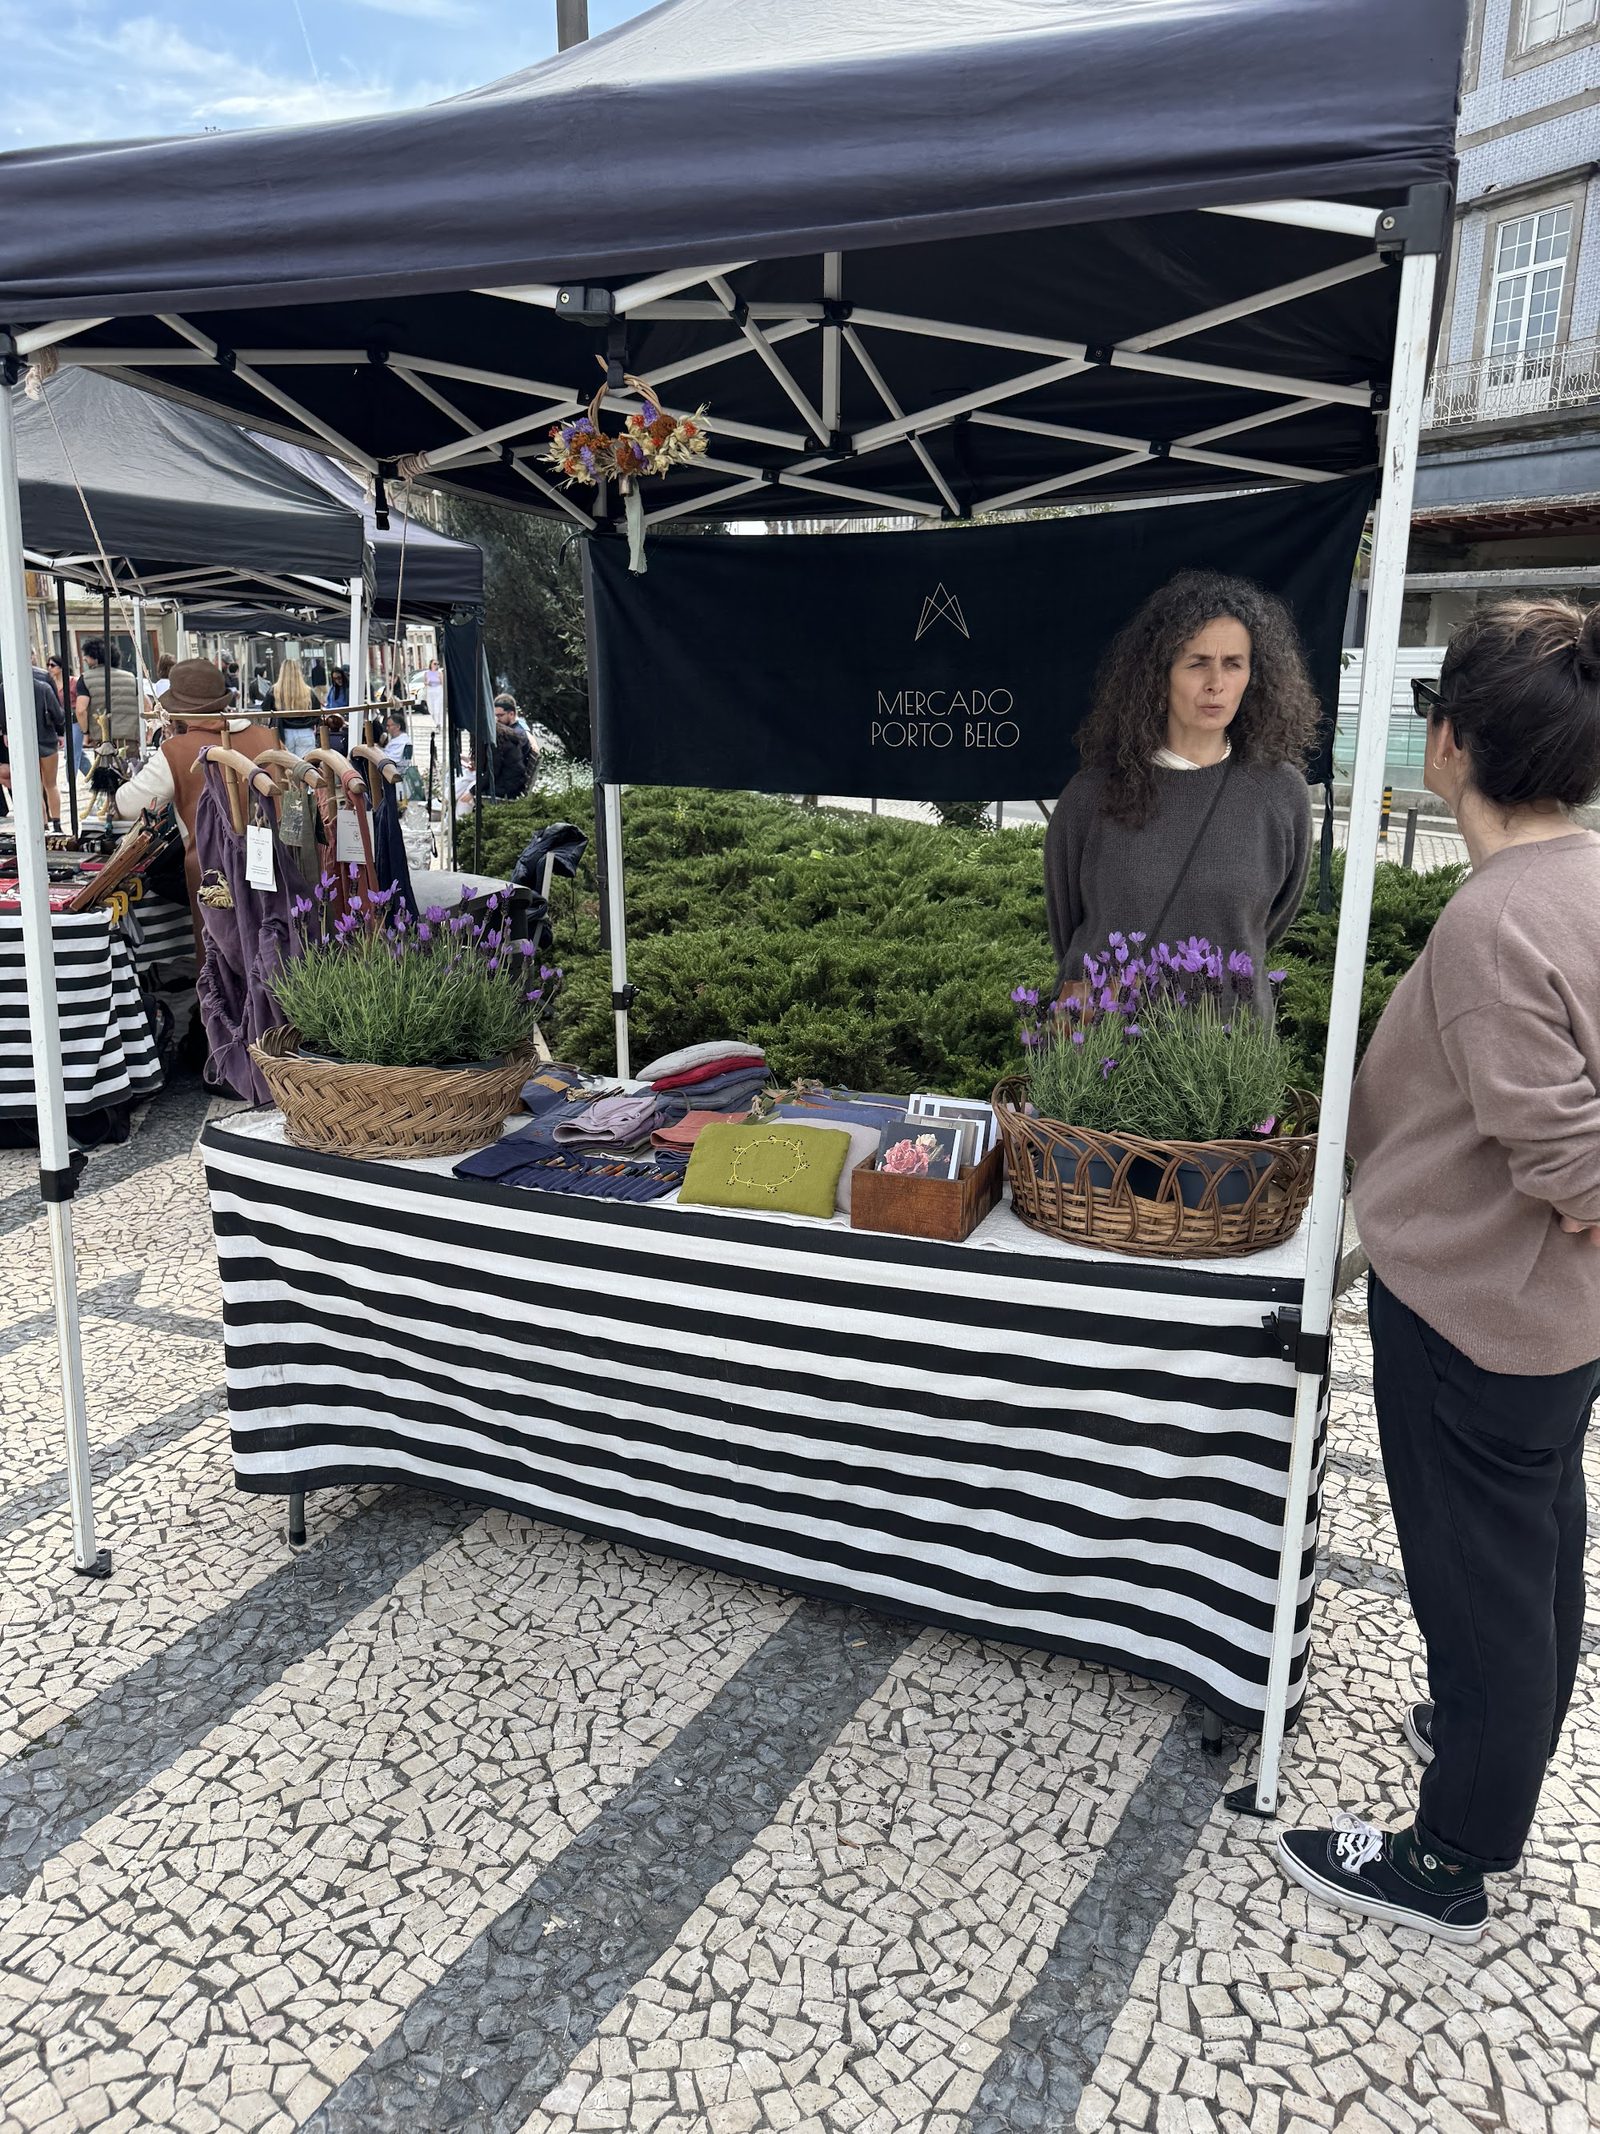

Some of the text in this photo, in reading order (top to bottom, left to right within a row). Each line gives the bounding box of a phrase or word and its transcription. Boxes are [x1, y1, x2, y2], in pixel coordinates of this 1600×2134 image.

[877, 688, 1014, 716] MERCADO
[871, 721, 1020, 748] PORTO BELO
